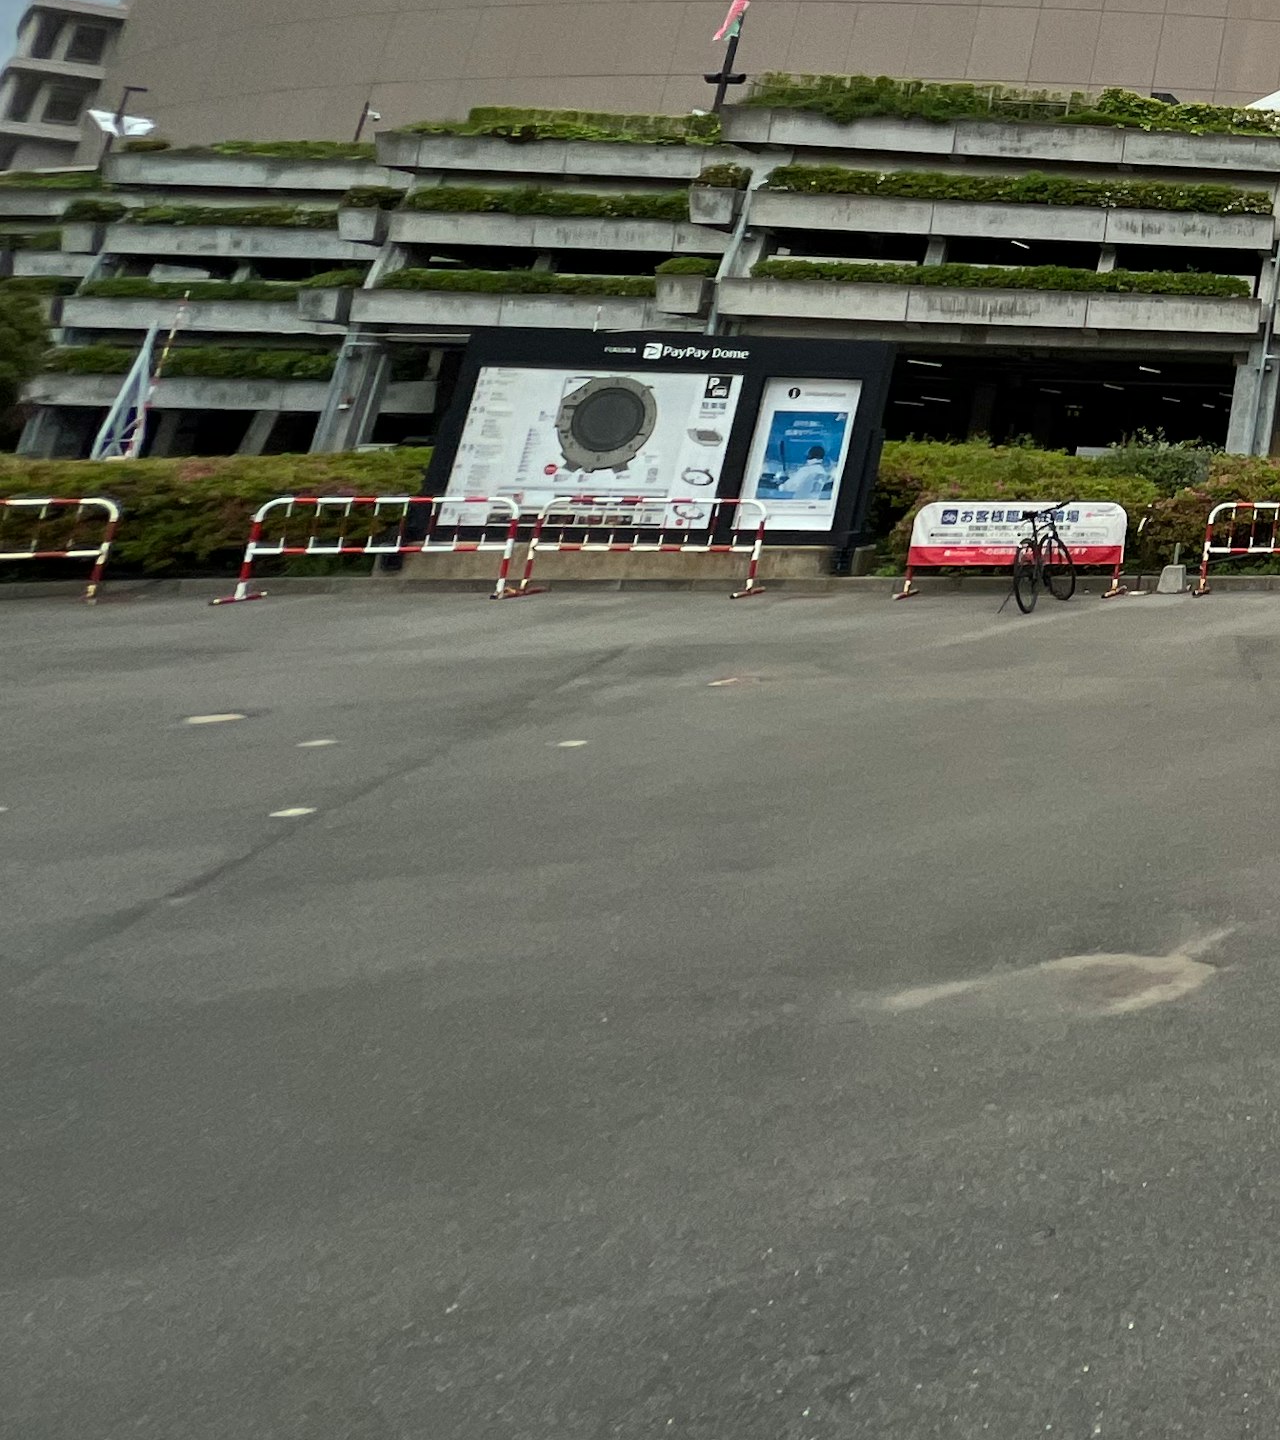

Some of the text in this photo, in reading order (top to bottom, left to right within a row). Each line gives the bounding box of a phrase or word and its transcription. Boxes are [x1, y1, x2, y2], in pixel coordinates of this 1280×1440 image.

[662, 346, 709, 359] PayPay
[712, 348, 750, 359] Dome
[708, 377, 720, 389] P
